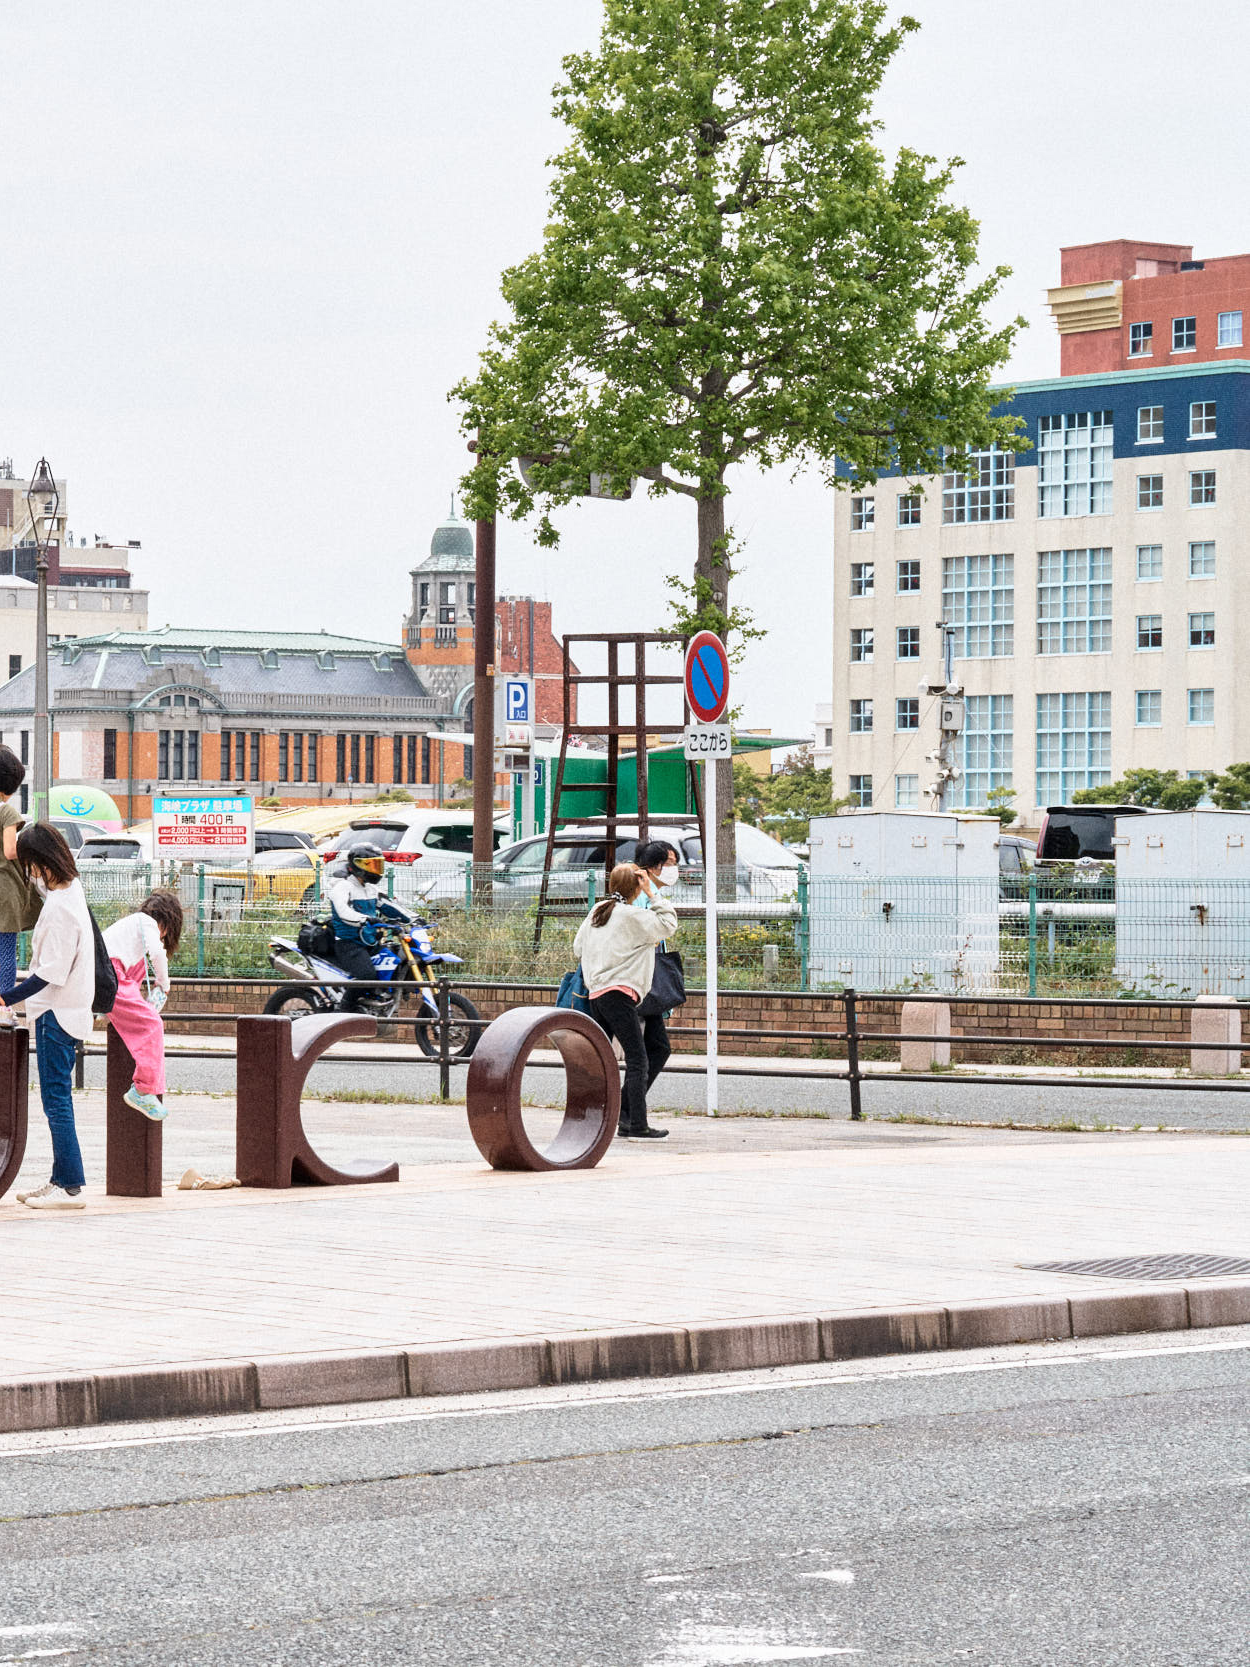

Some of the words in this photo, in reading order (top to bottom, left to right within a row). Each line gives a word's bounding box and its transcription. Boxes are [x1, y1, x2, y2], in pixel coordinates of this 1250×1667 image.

[509, 684, 526, 720] P
[689, 732, 728, 752] ここから
[161, 800, 210, 812] 海峡プラザ
[212, 800, 243, 812] 駐車場
